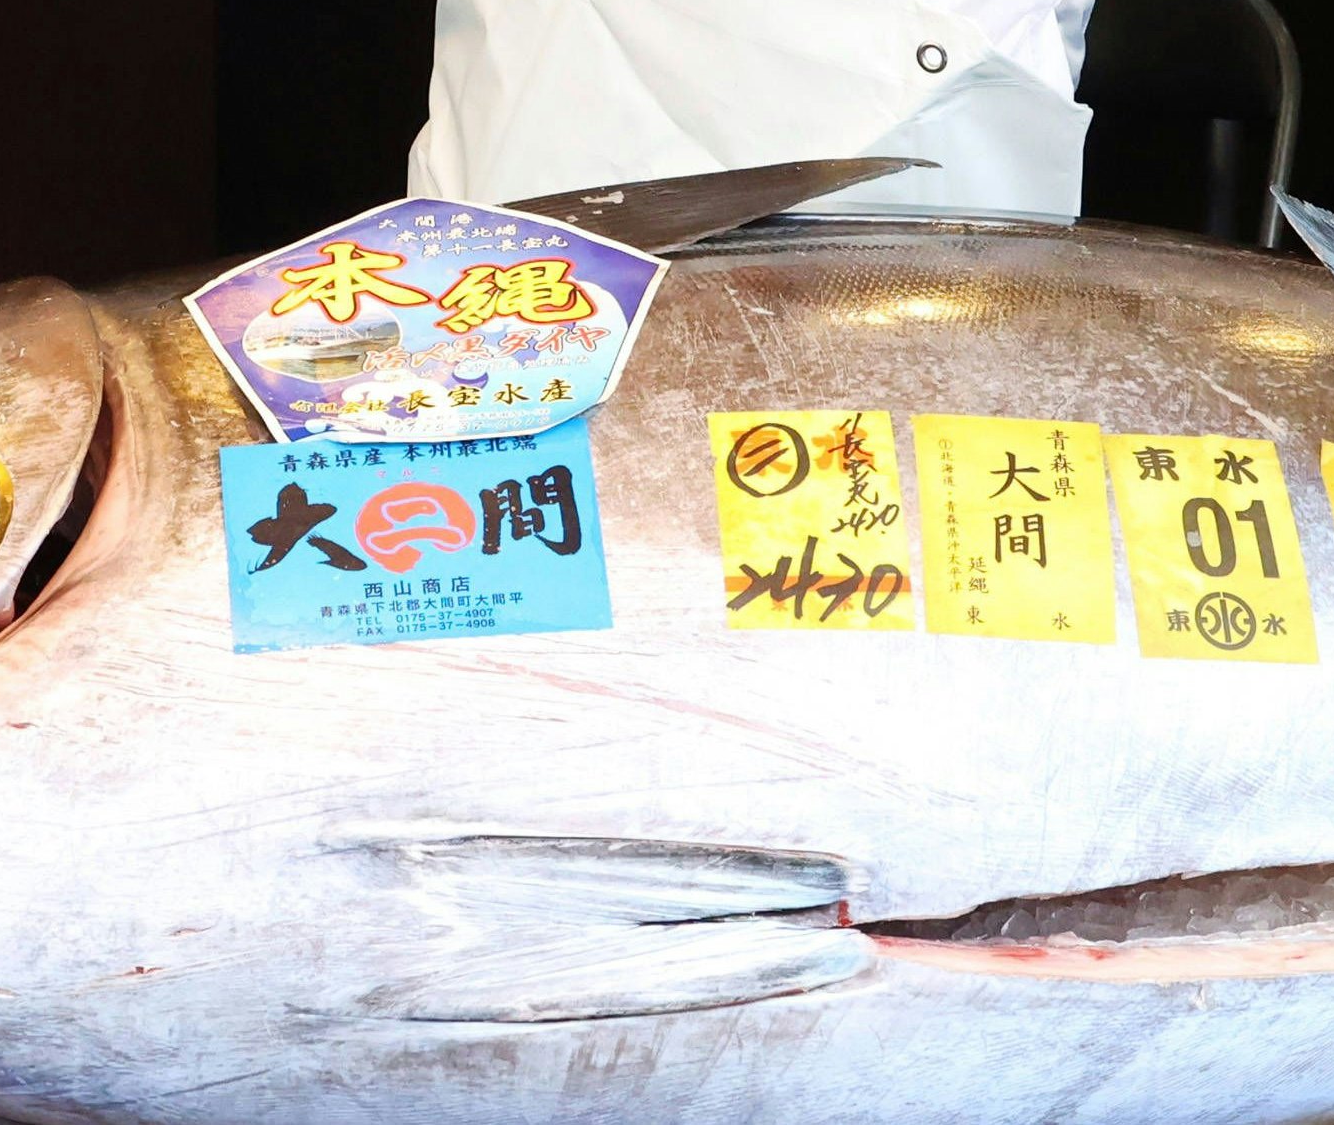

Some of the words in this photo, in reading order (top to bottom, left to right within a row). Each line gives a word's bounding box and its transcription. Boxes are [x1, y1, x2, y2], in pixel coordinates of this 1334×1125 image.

[399, 378, 574, 413] 長宝水産
[278, 448, 387, 473] 青森県産
[1046, 430, 1076, 497] 青森県
[989, 451, 1051, 569] 大間
[1181, 497, 1281, 579] 01
[364, 576, 471, 599] 西山商店
[357, 616, 382, 626] TEL
[357, 626, 384, 636] FAX
